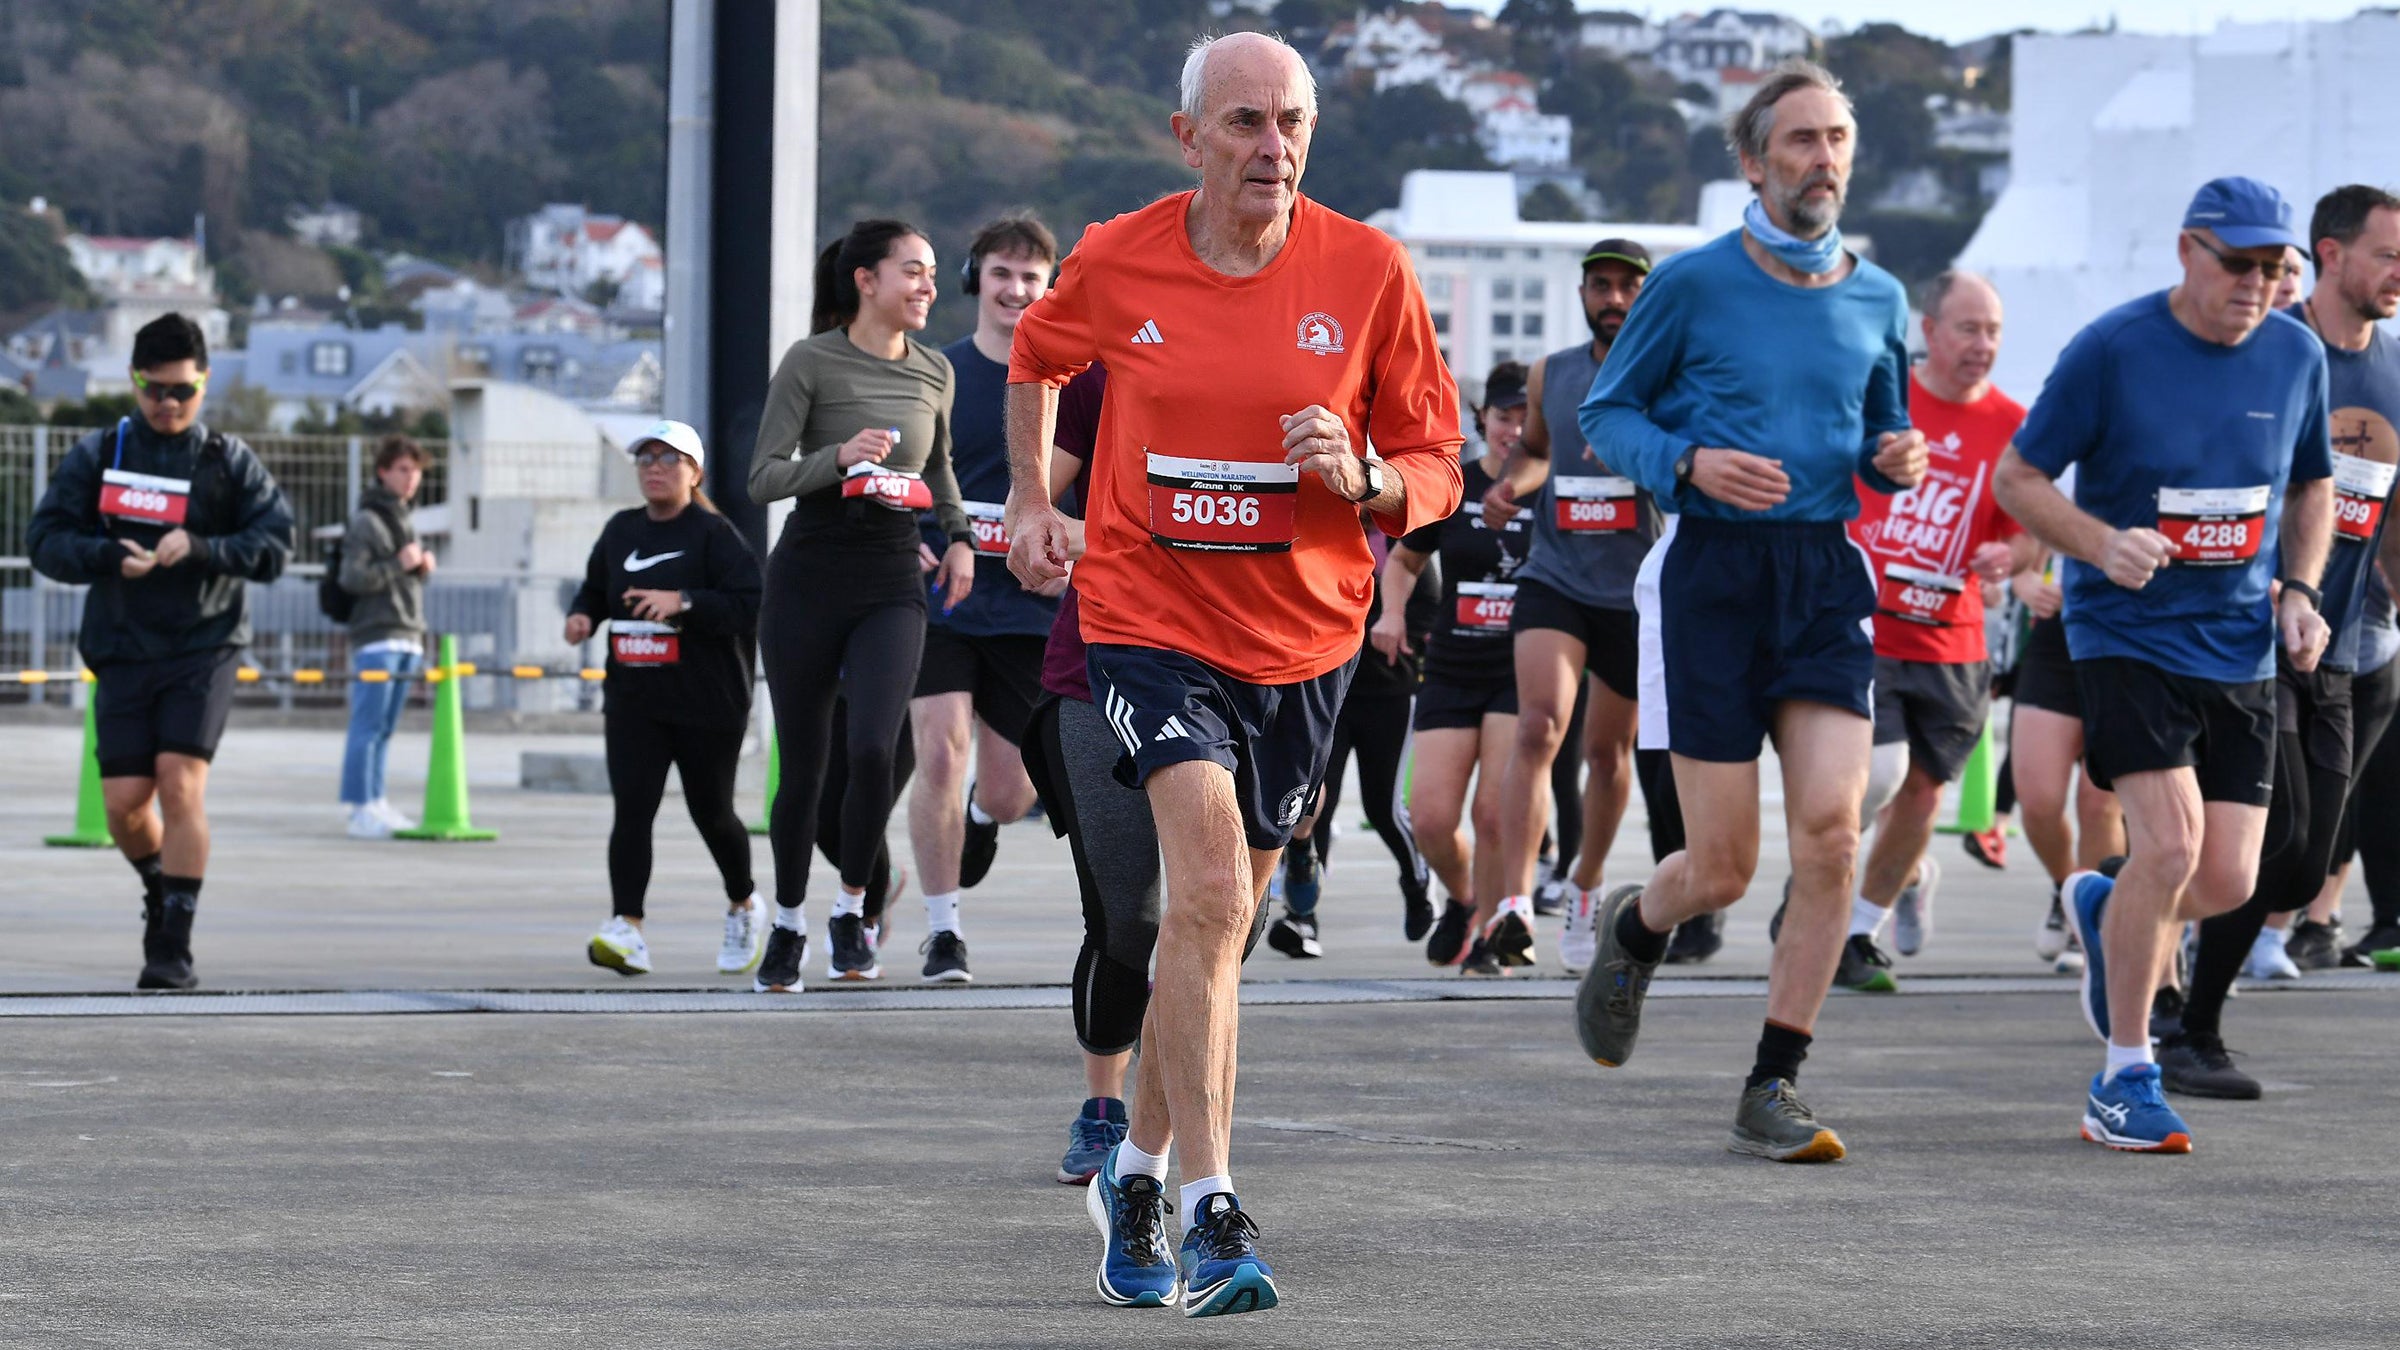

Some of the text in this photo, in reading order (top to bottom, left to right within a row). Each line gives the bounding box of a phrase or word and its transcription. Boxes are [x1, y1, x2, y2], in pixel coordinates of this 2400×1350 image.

[1181, 470, 1256, 481] WELLINGTON MARATHON
[1229, 484, 1244, 492] 10K
[118, 490, 168, 512] 4959
[1171, 493, 1260, 526] 5036
[1570, 502, 1616, 521] 5089
[2334, 496, 2371, 525] 099
[970, 522, 1010, 544] 501
[2183, 523, 2247, 547] 4288
[1172, 541, 1258, 551] www.wellingtonmarathon.kiwi
[1899, 586, 1948, 611] 4307
